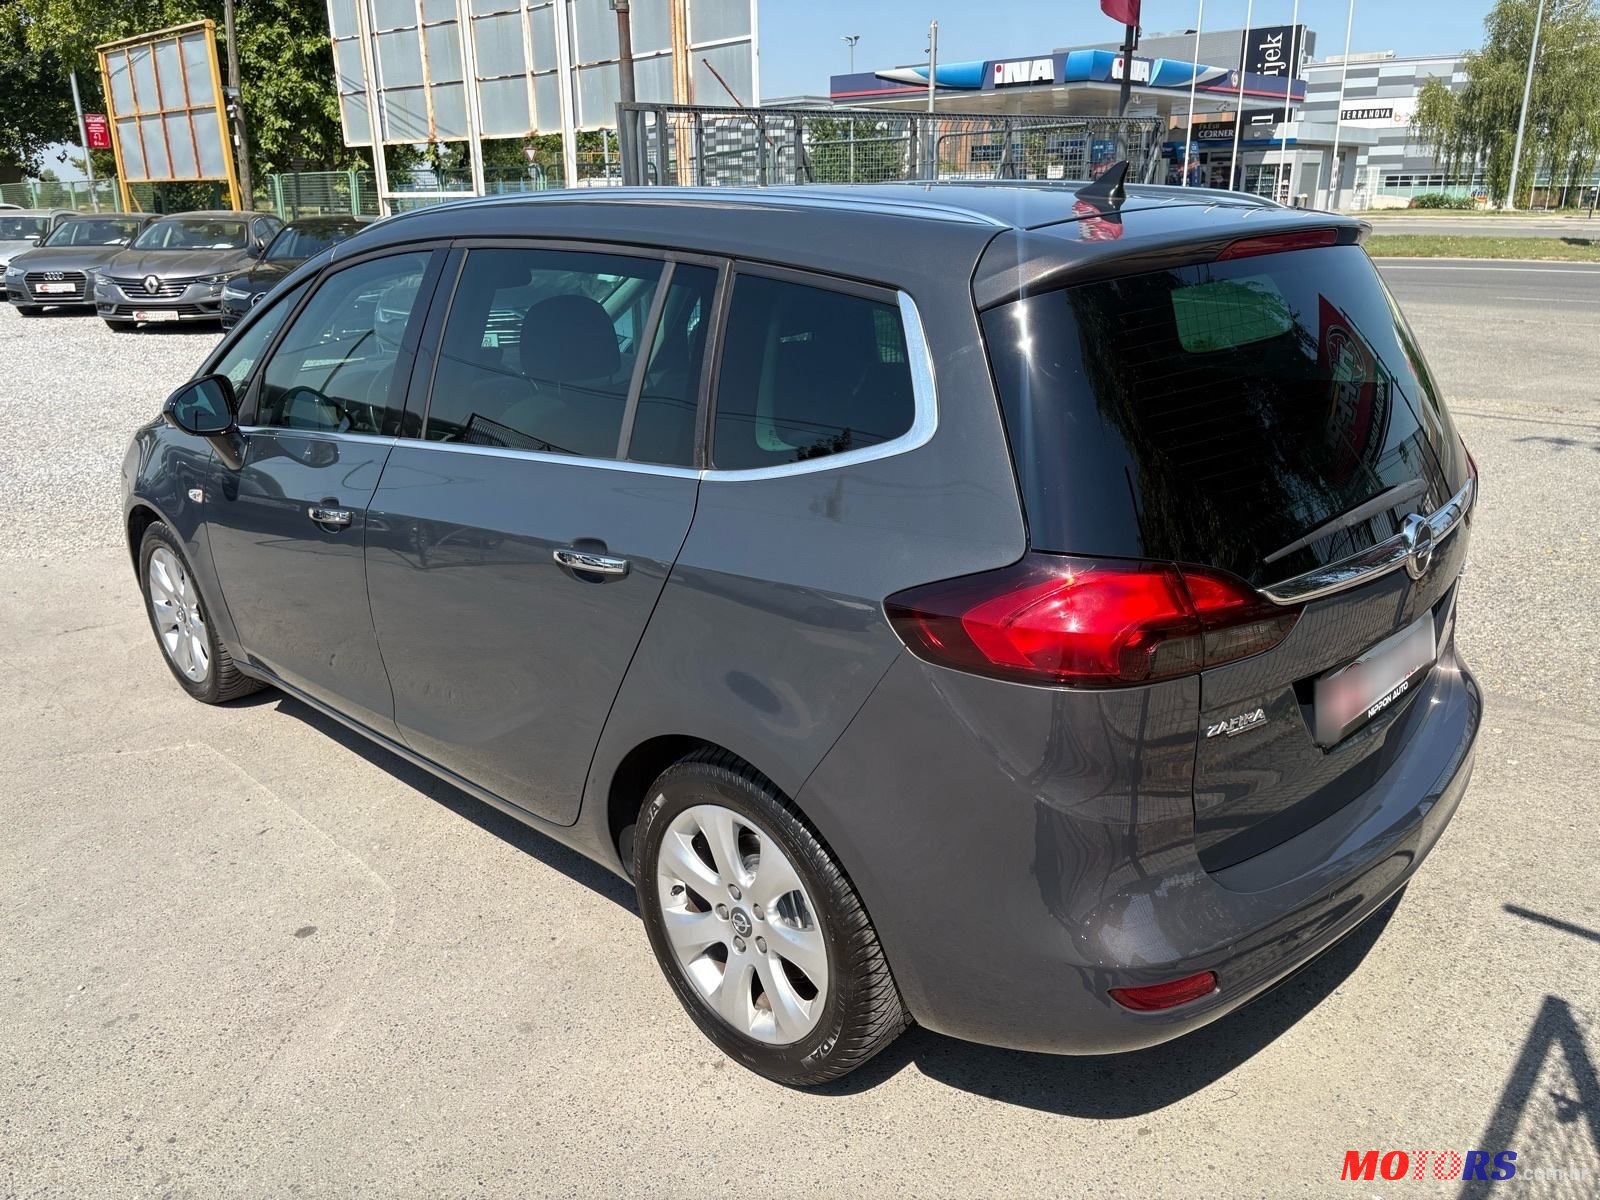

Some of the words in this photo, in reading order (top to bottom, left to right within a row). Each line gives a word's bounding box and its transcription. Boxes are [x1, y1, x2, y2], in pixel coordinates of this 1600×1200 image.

[994, 58, 1055, 85] INA
[1342, 109, 1391, 120] TERRANOVA
[1198, 129, 1234, 139] CORNER
[1368, 694, 1393, 719] NIPPON
[1393, 681, 1409, 700] AUTO
[1206, 708, 1266, 738] ZAFIRA
